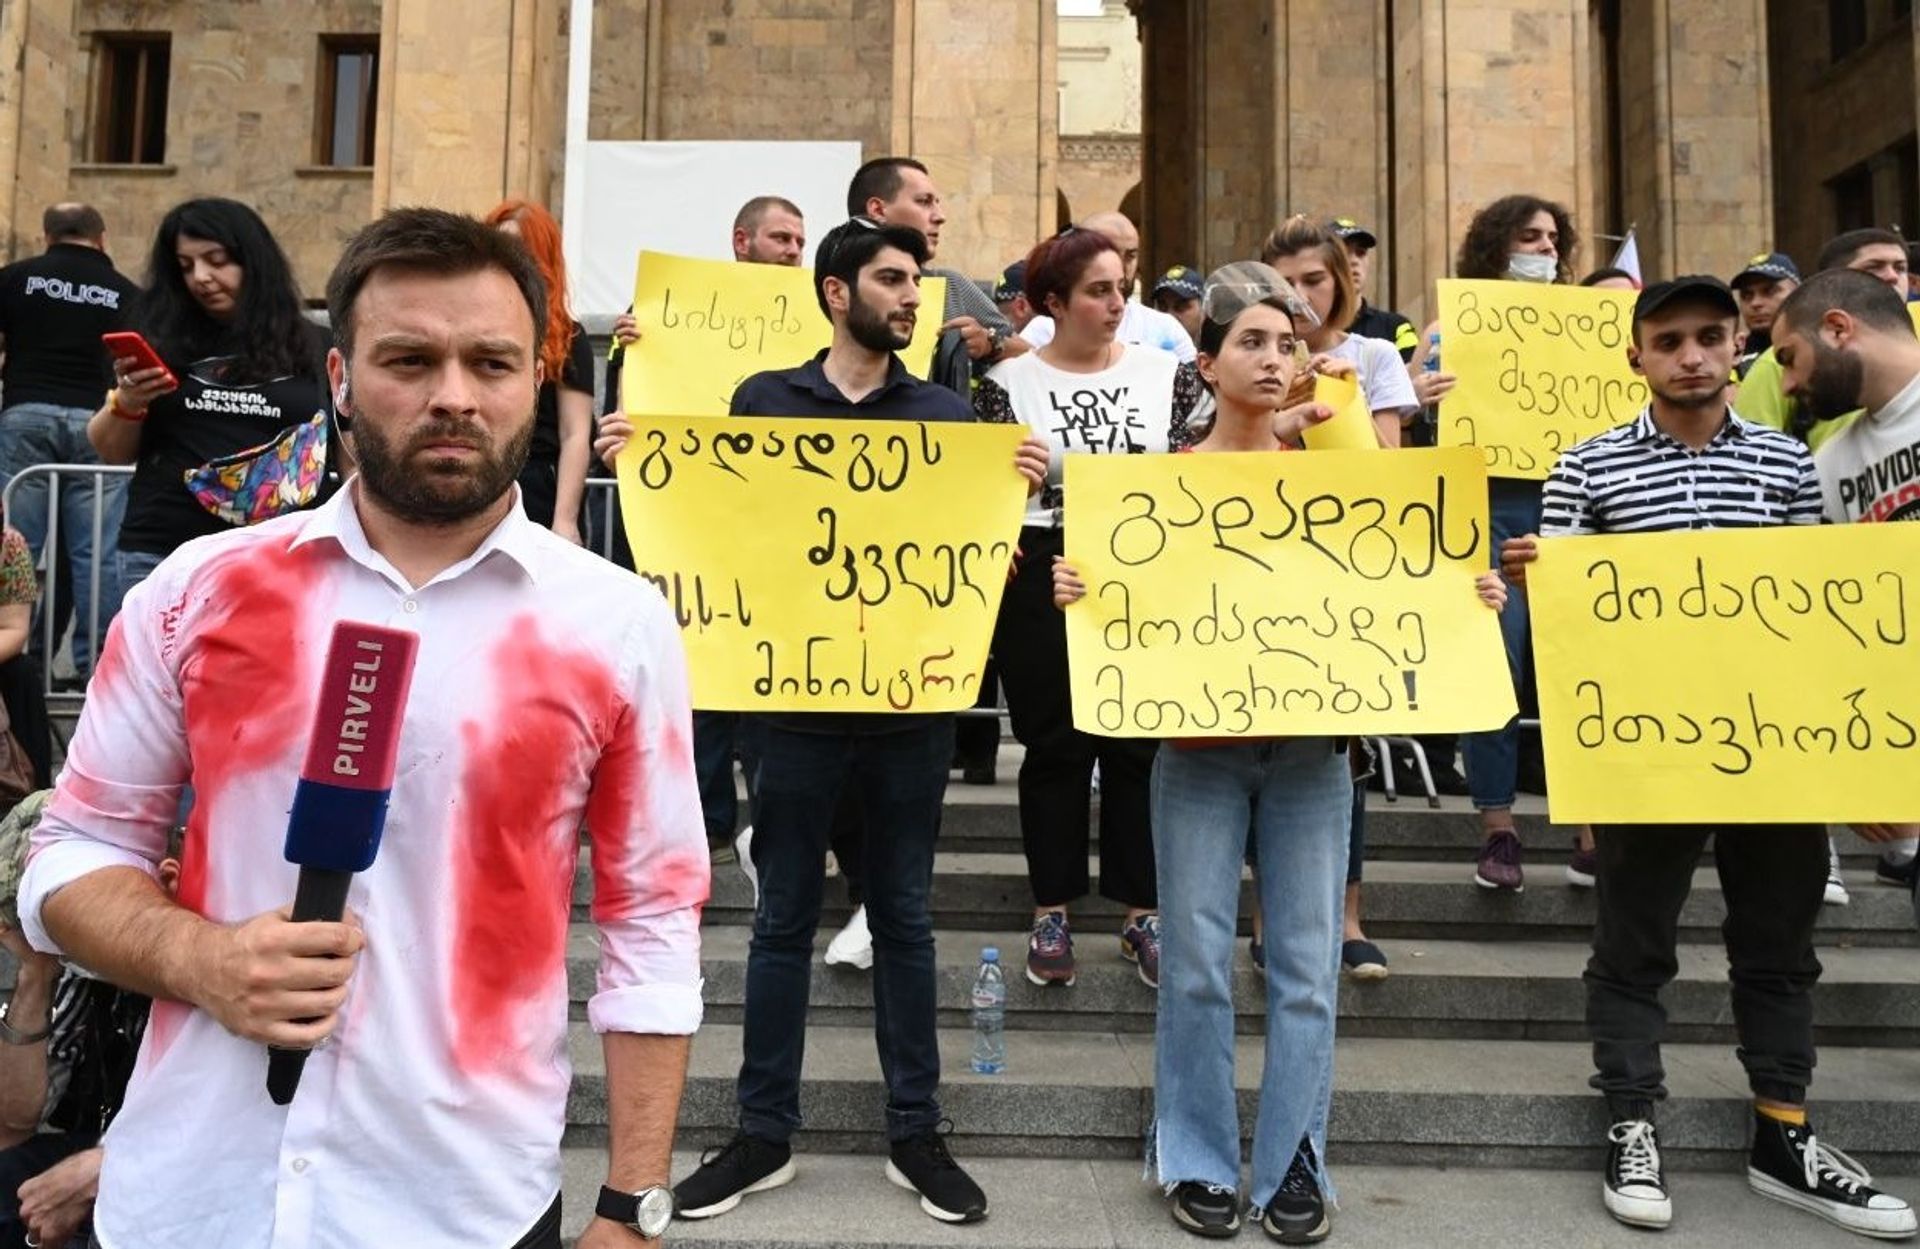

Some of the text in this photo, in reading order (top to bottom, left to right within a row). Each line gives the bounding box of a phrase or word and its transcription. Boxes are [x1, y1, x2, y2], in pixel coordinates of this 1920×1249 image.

[26, 276, 119, 309] POLICE
[662, 287, 801, 354] სისტემა
[1457, 291, 1637, 351] გადადგ
[639, 422, 942, 492] გადადგეს
[1110, 475, 1481, 580] გადადგეს
[1098, 580, 1428, 669] მოძალადე
[333, 640, 383, 776] PIRVELI
[754, 637, 977, 711] მინისტრი
[1096, 663, 1420, 734] მთავრობა!
[1576, 680, 1918, 775] მთავრობა
